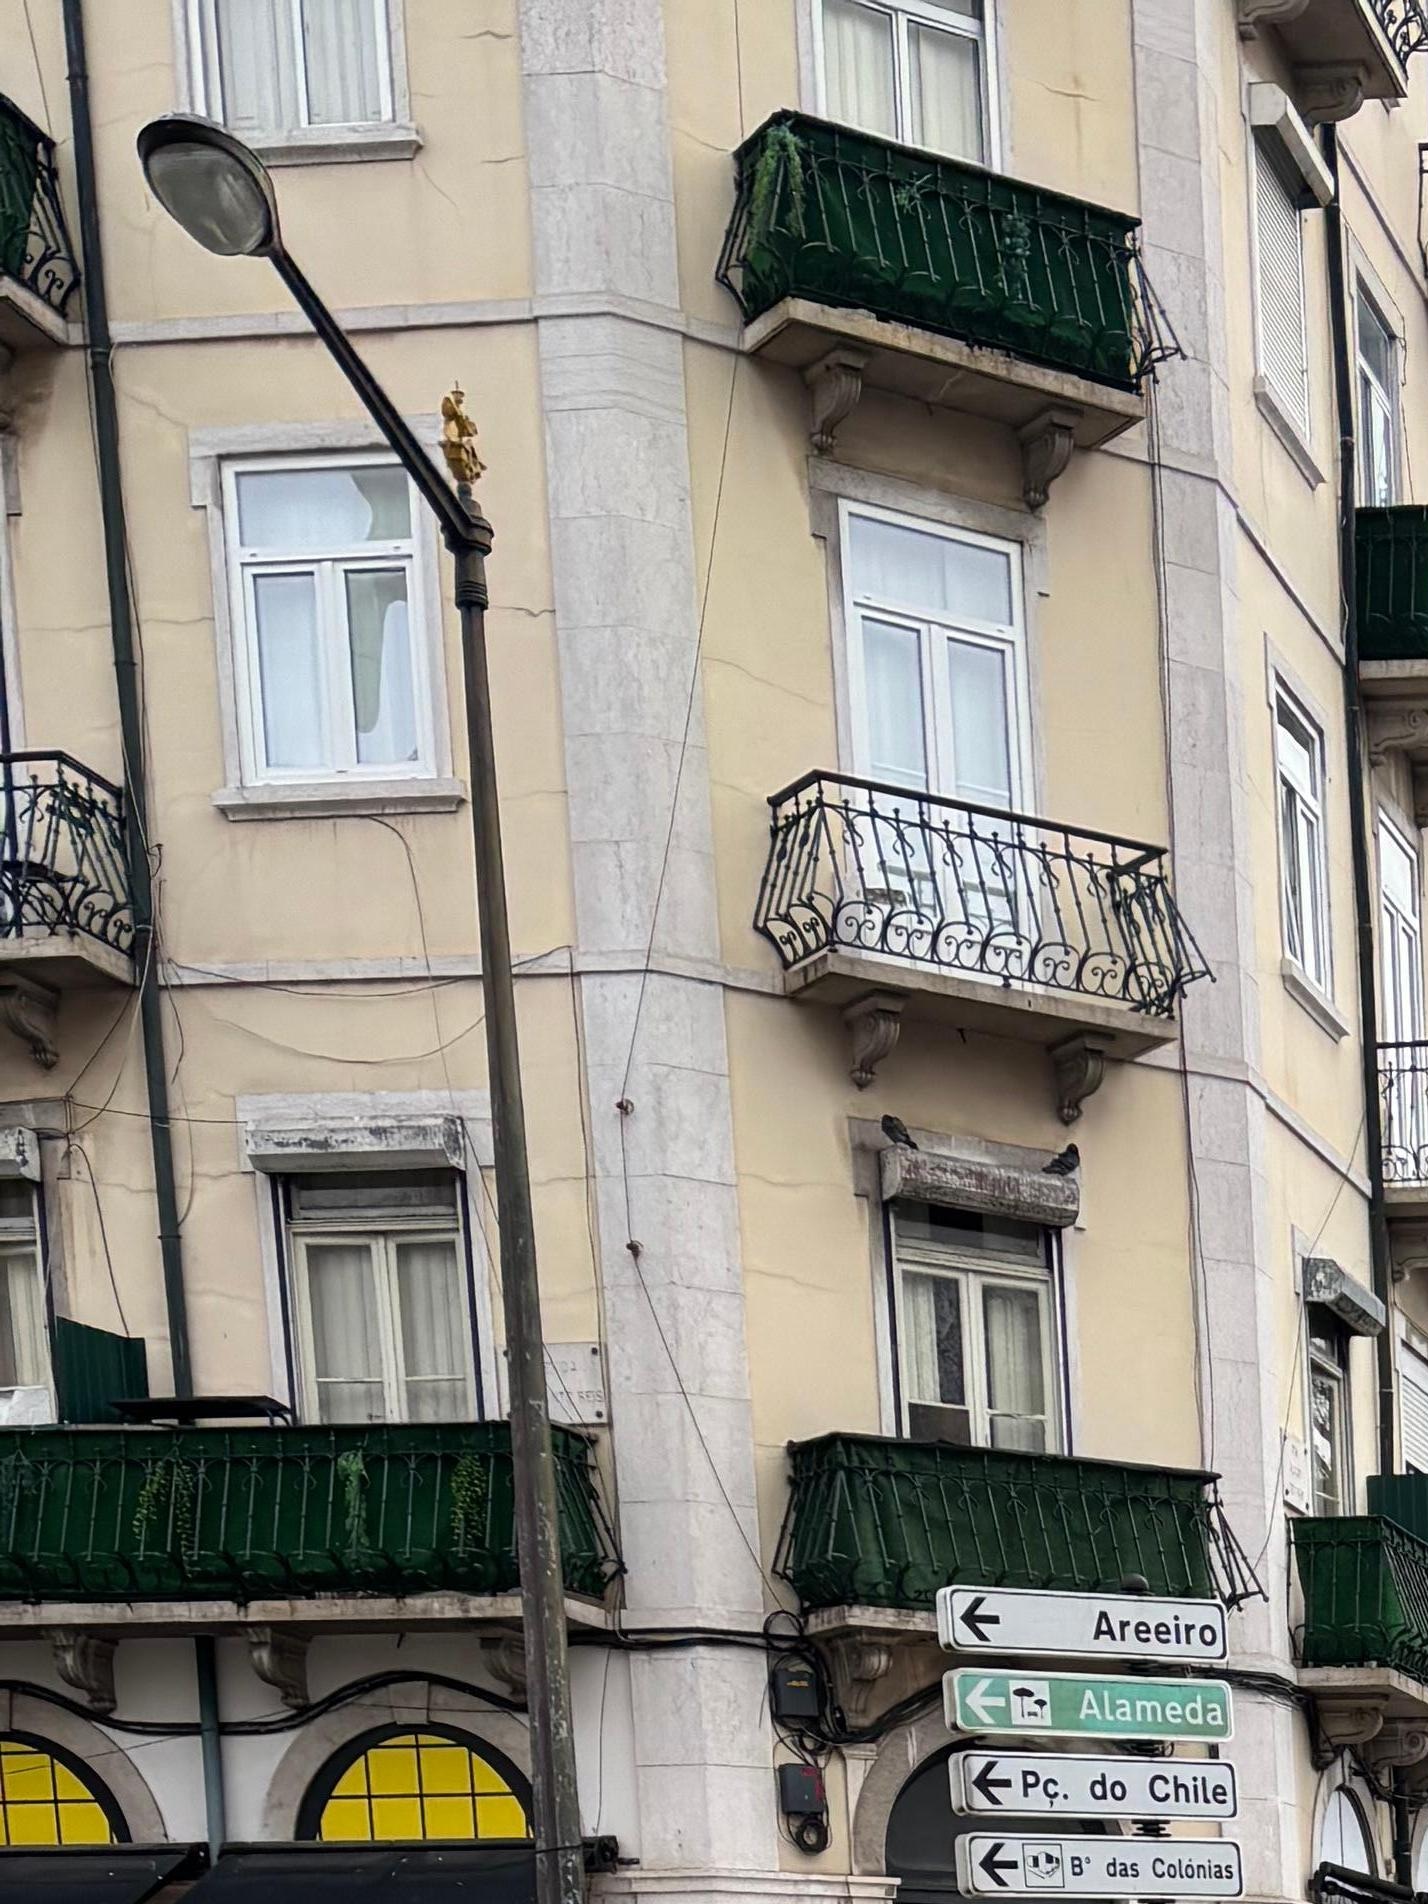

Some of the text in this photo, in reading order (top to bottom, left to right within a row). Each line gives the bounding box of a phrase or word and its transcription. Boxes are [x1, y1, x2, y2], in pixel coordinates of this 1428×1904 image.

[1092, 1610, 1218, 1648] Areeiro
[1079, 1688, 1225, 1727] Alameda
[1021, 1769, 1229, 1808] Pç. do Chile
[1106, 1857, 1140, 1878] das
[1151, 1856, 1234, 1880] Colónias
